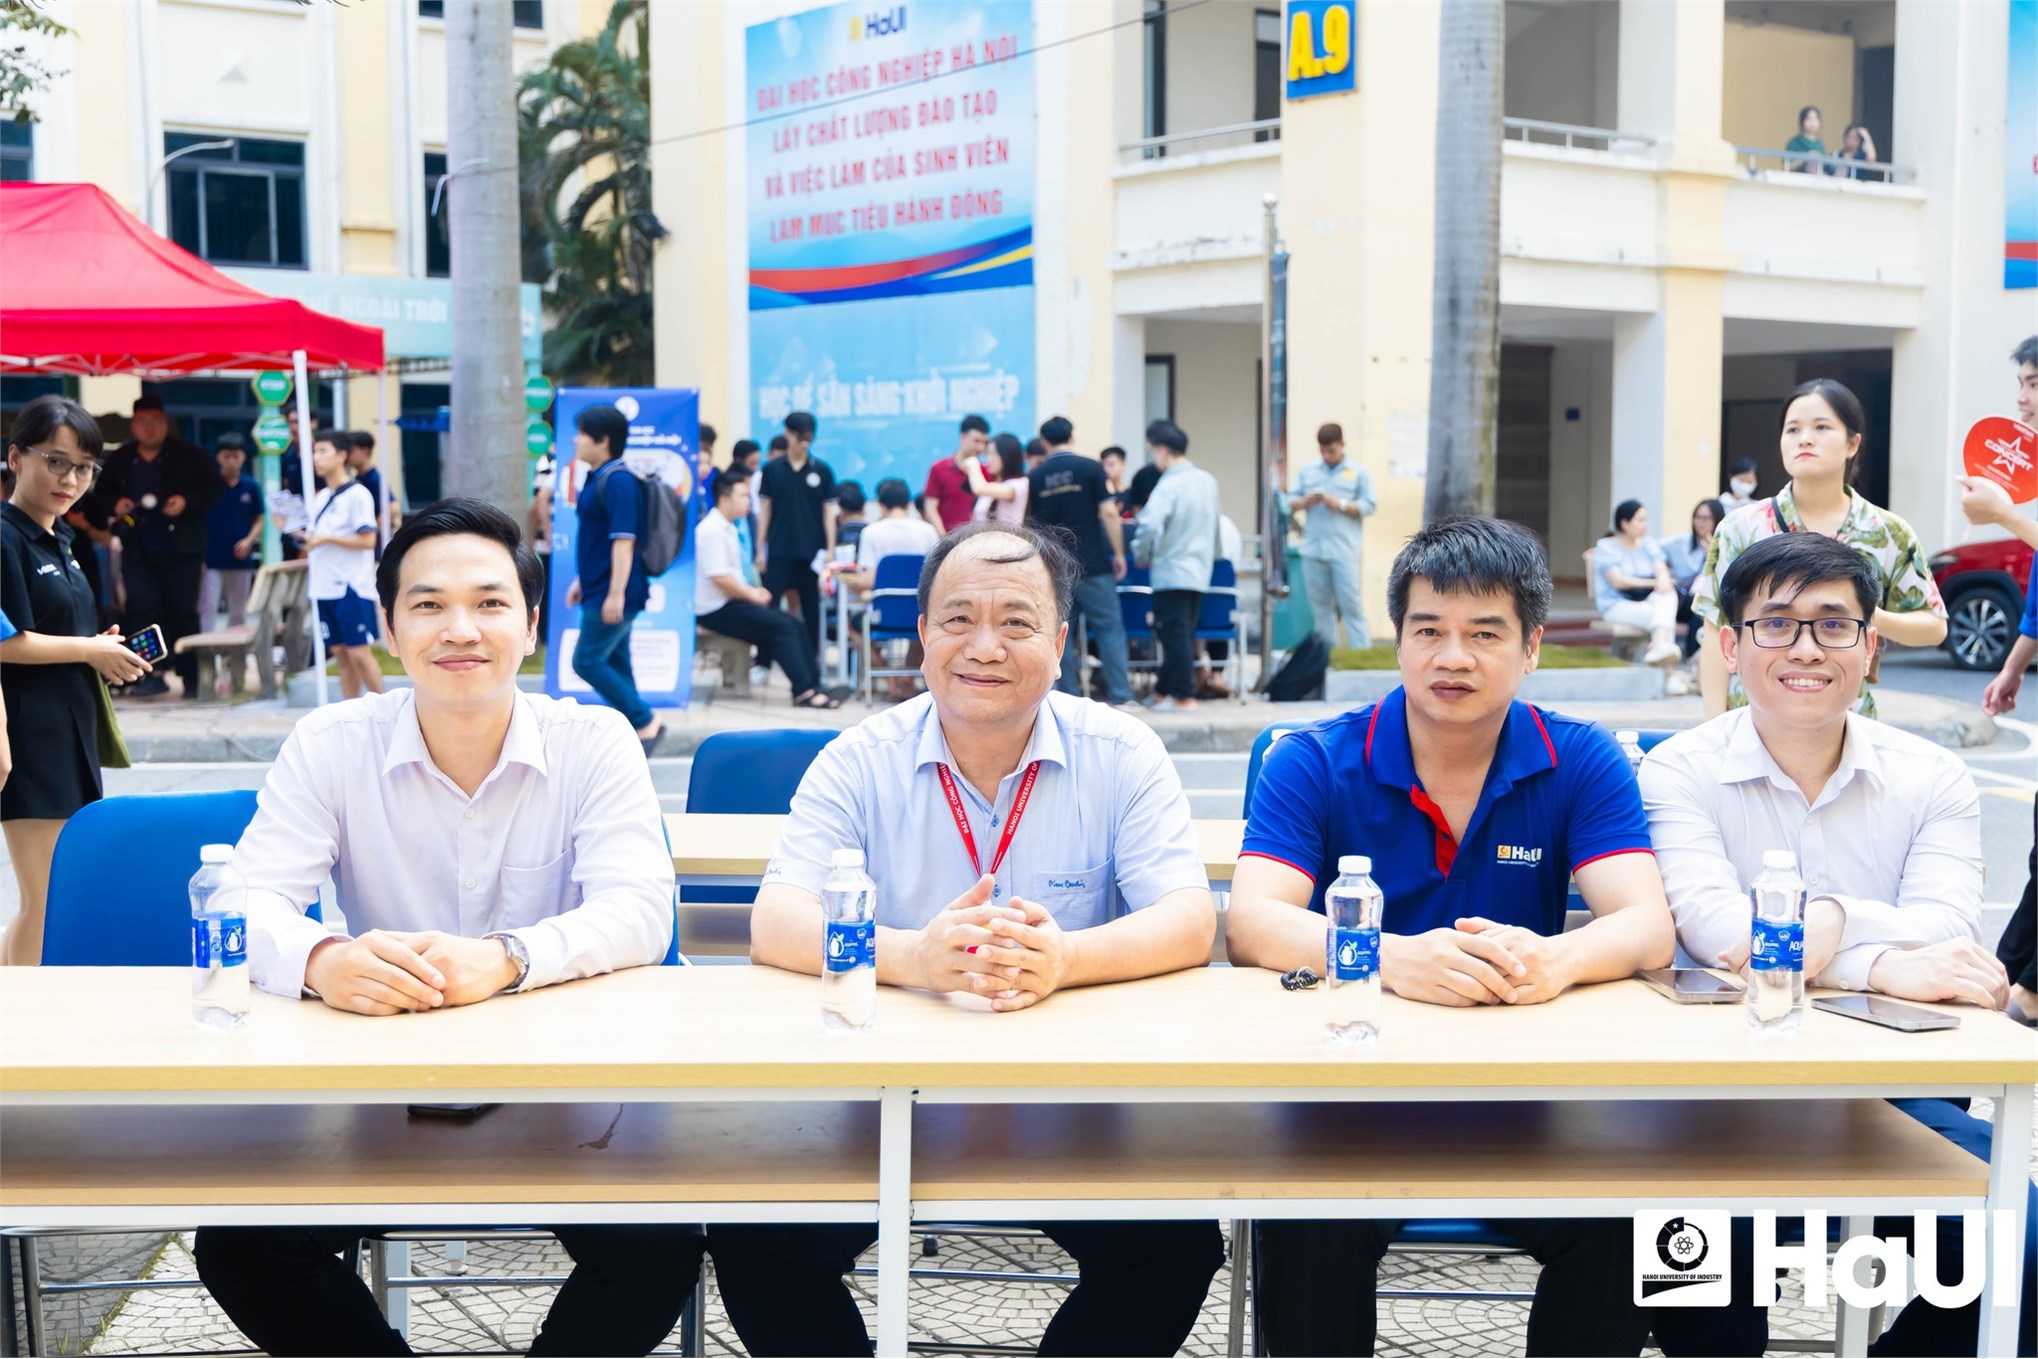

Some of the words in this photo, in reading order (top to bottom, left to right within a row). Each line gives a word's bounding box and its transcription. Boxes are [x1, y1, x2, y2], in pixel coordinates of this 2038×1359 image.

[866, 8, 905, 37] HaUI
[1288, 5, 1350, 81] A.9
[827, 66, 870, 96] CÔNG
[879, 48, 942, 83] NGHIỆP
[915, 147, 957, 176] SINH
[965, 136, 1008, 168] VIÊN
[1007, 811, 1020, 835] HANOI
[1016, 772, 1035, 812] UNIVERSITY
